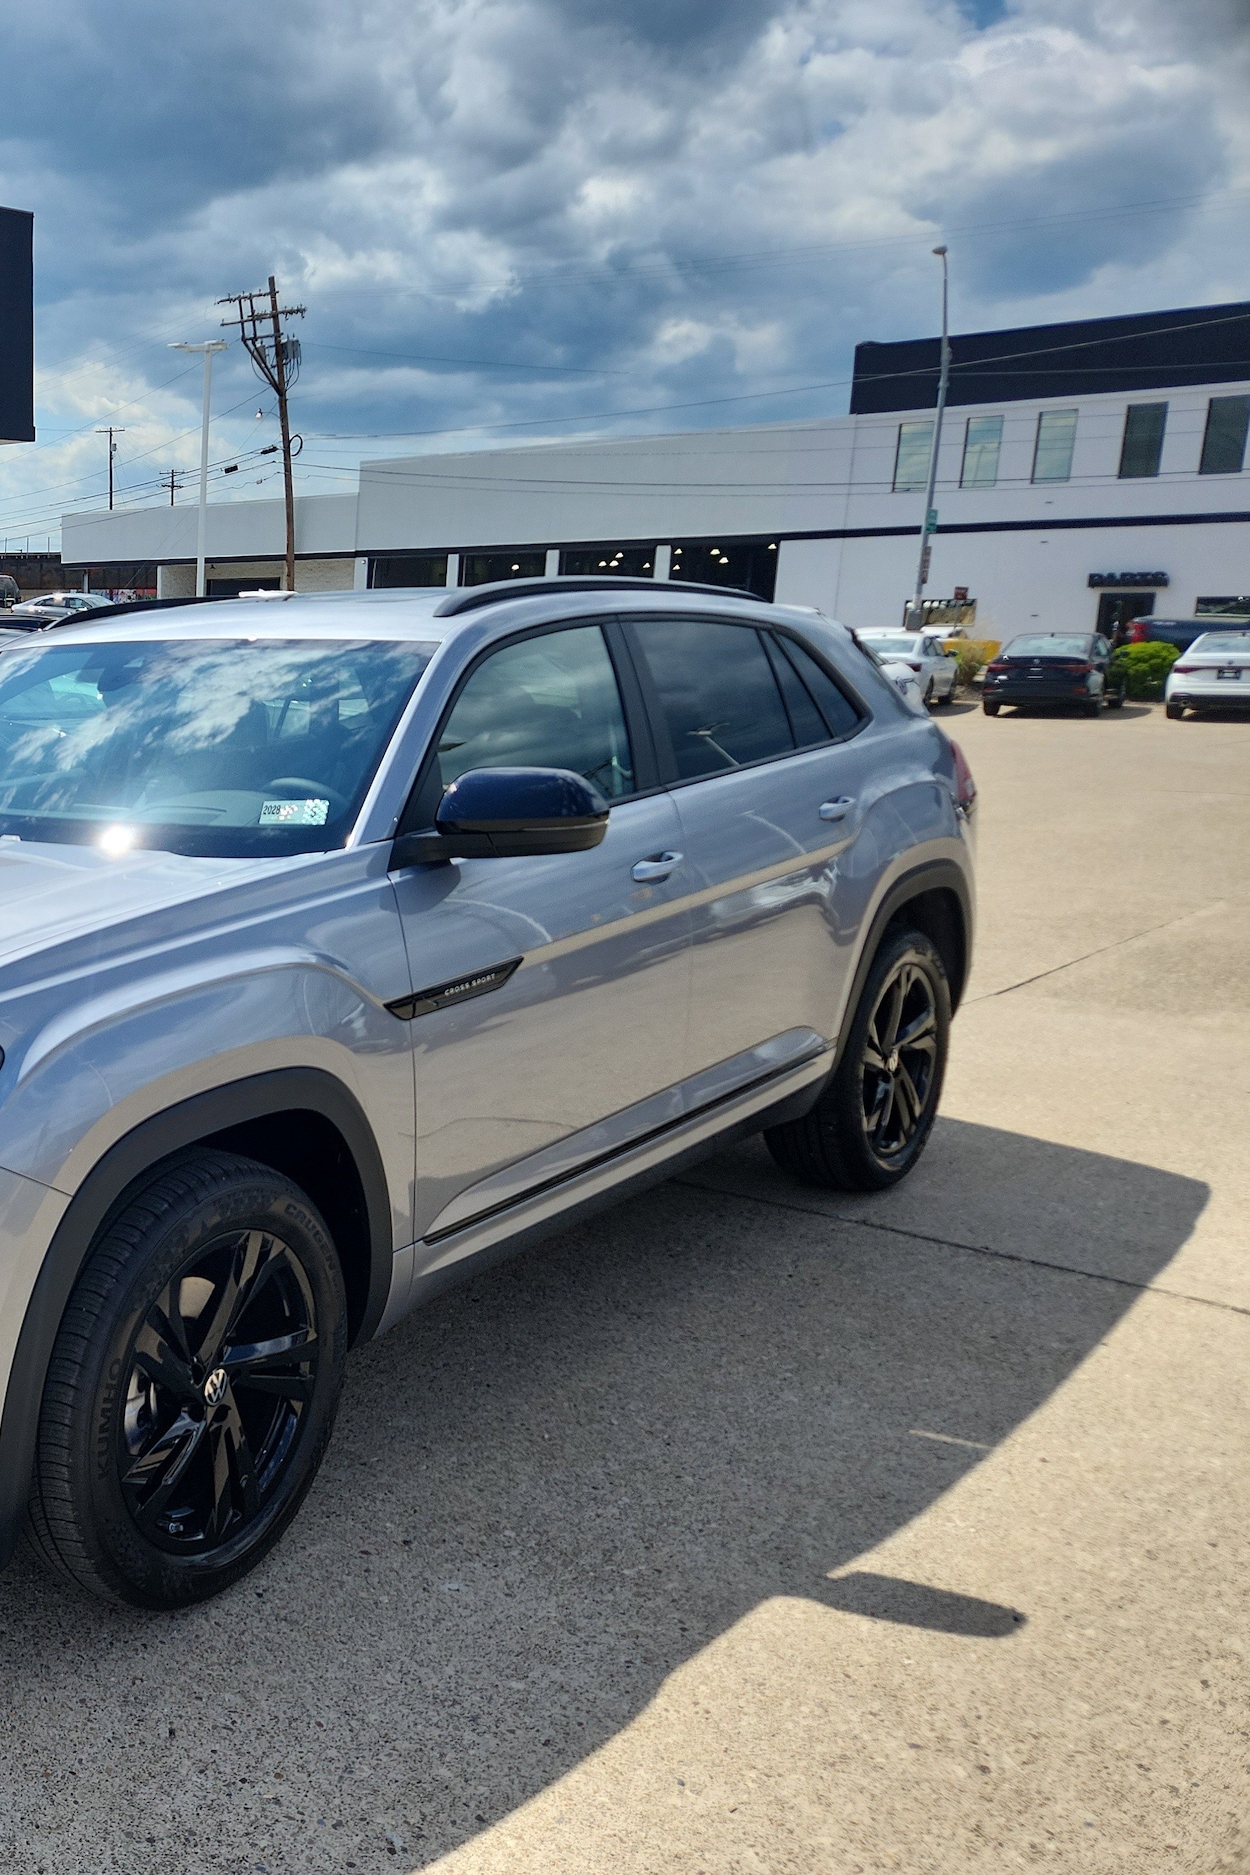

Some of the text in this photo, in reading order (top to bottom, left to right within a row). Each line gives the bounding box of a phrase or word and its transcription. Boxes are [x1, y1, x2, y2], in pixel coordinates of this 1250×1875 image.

[444, 972, 496, 996] CROSS SPORT
[96, 1357, 122, 1481] KUMHO
